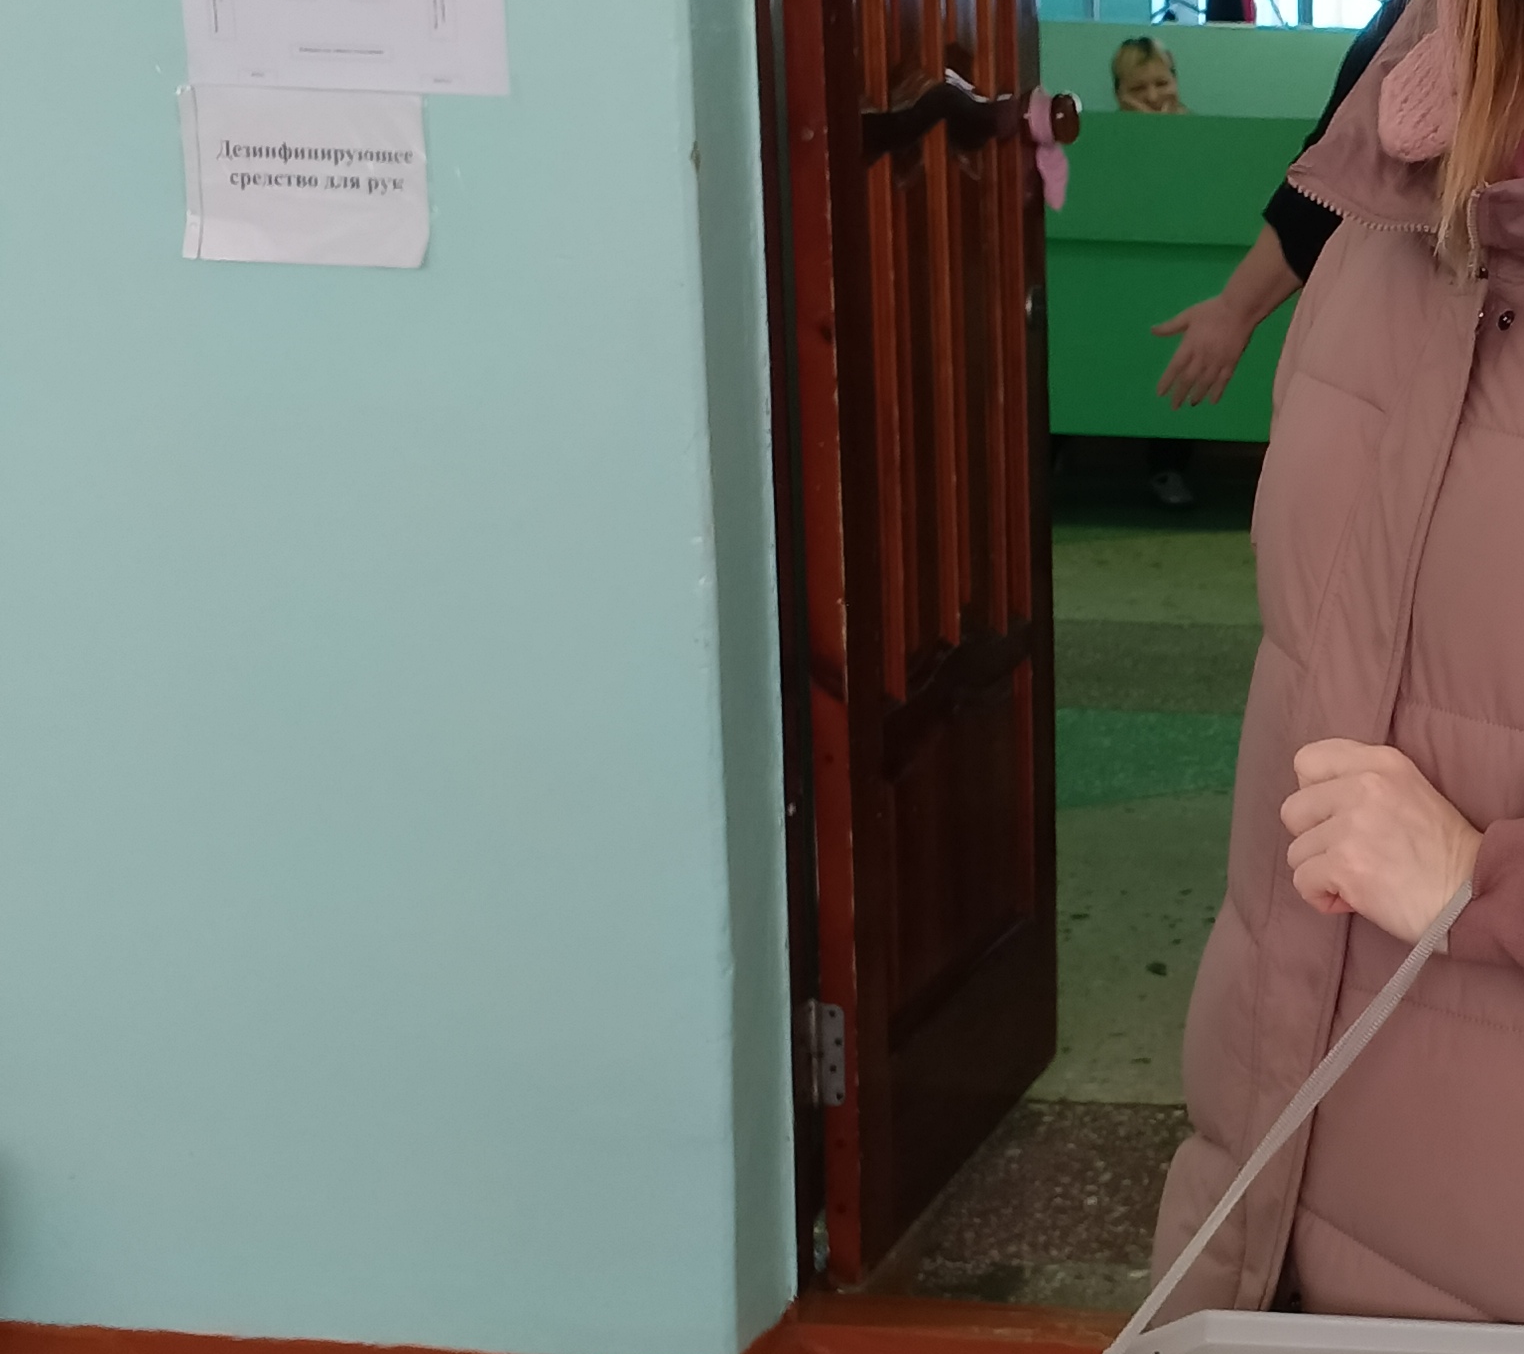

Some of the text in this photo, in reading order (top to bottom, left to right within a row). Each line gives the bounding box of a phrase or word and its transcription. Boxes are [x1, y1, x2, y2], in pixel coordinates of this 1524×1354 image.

[216, 140, 414, 167] Дезинфицирующее
[229, 171, 404, 195] средство для рук
